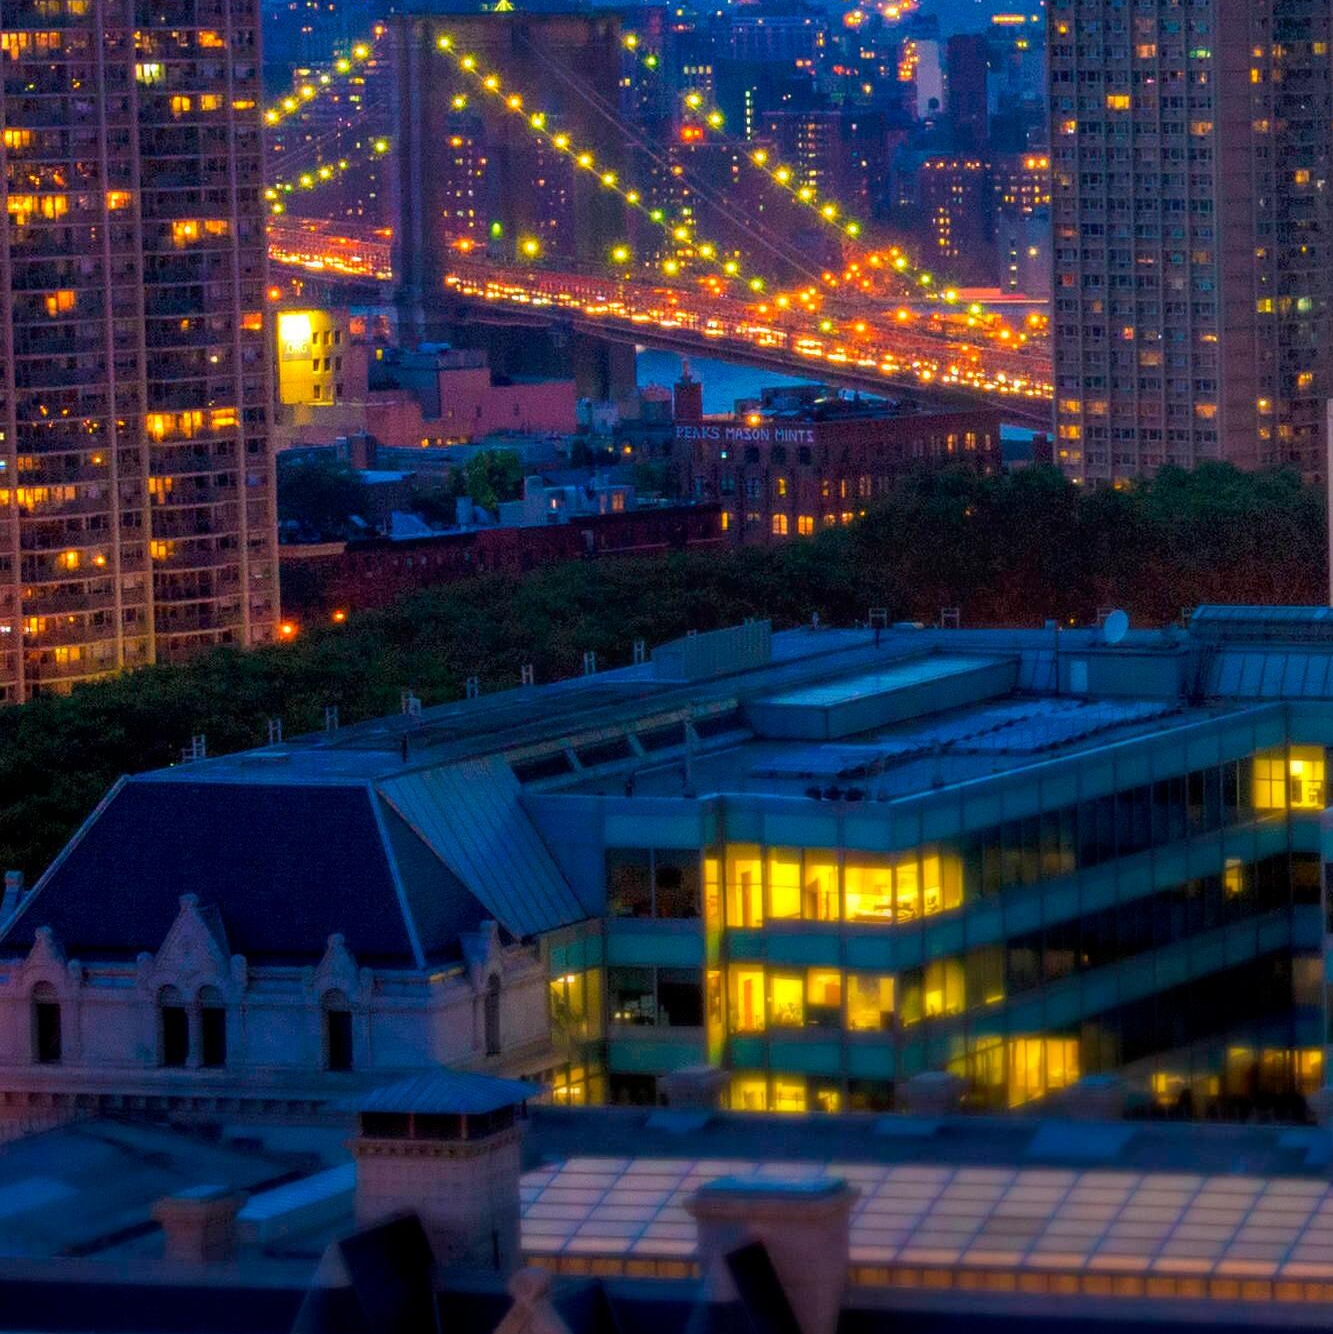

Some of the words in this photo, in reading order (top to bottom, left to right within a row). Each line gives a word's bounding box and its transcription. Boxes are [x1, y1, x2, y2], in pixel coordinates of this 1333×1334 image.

[676, 426, 720, 439] PEAKS
[725, 427, 770, 441] MASON
[775, 429, 815, 443] MINTS
